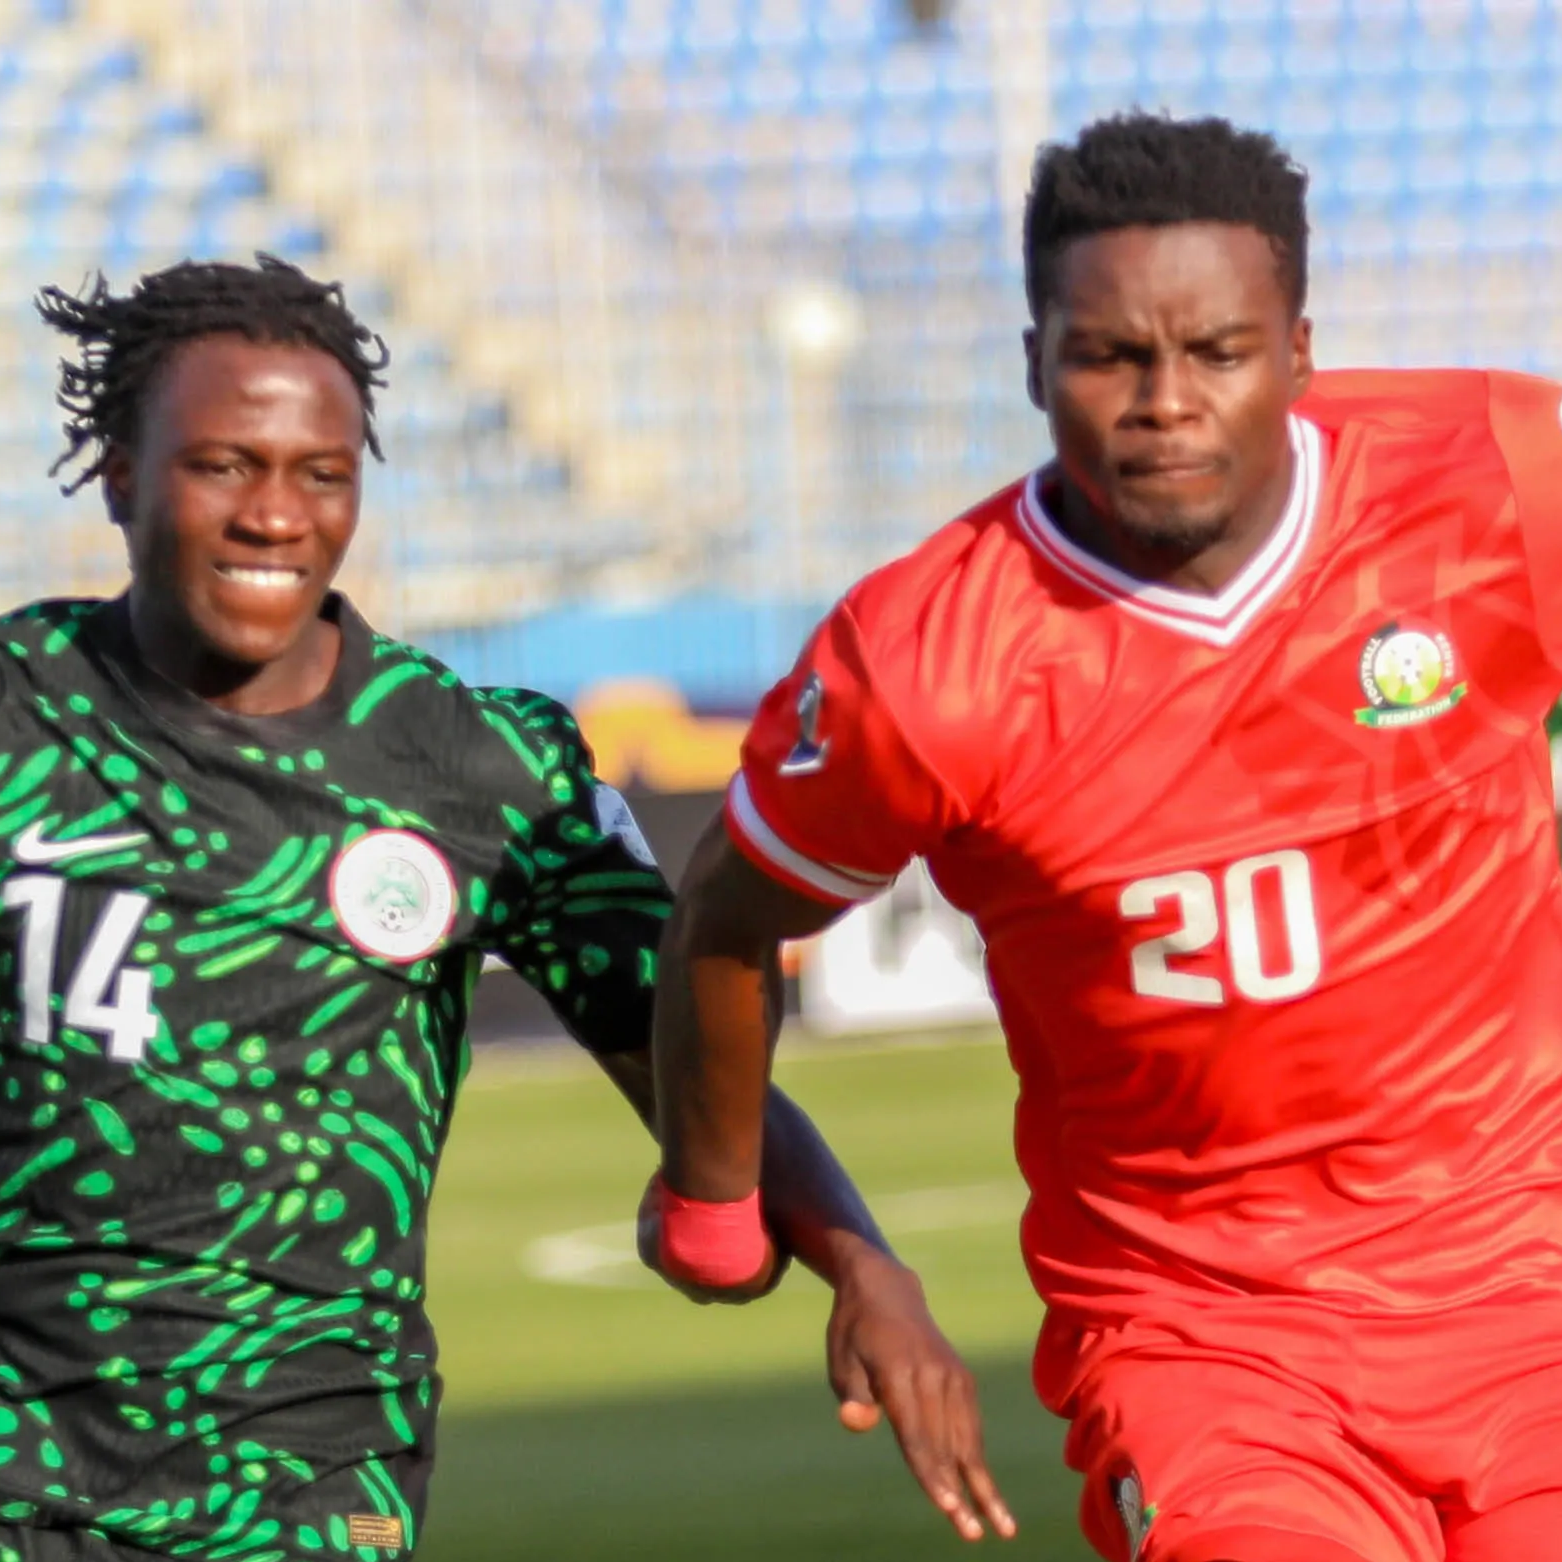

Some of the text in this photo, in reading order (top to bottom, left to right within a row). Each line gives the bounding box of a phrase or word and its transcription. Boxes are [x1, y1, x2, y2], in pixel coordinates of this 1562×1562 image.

[1377, 698, 1451, 725] FEDERATION
[3, 874, 161, 1064] 14
[1121, 850, 1322, 1003] 20
